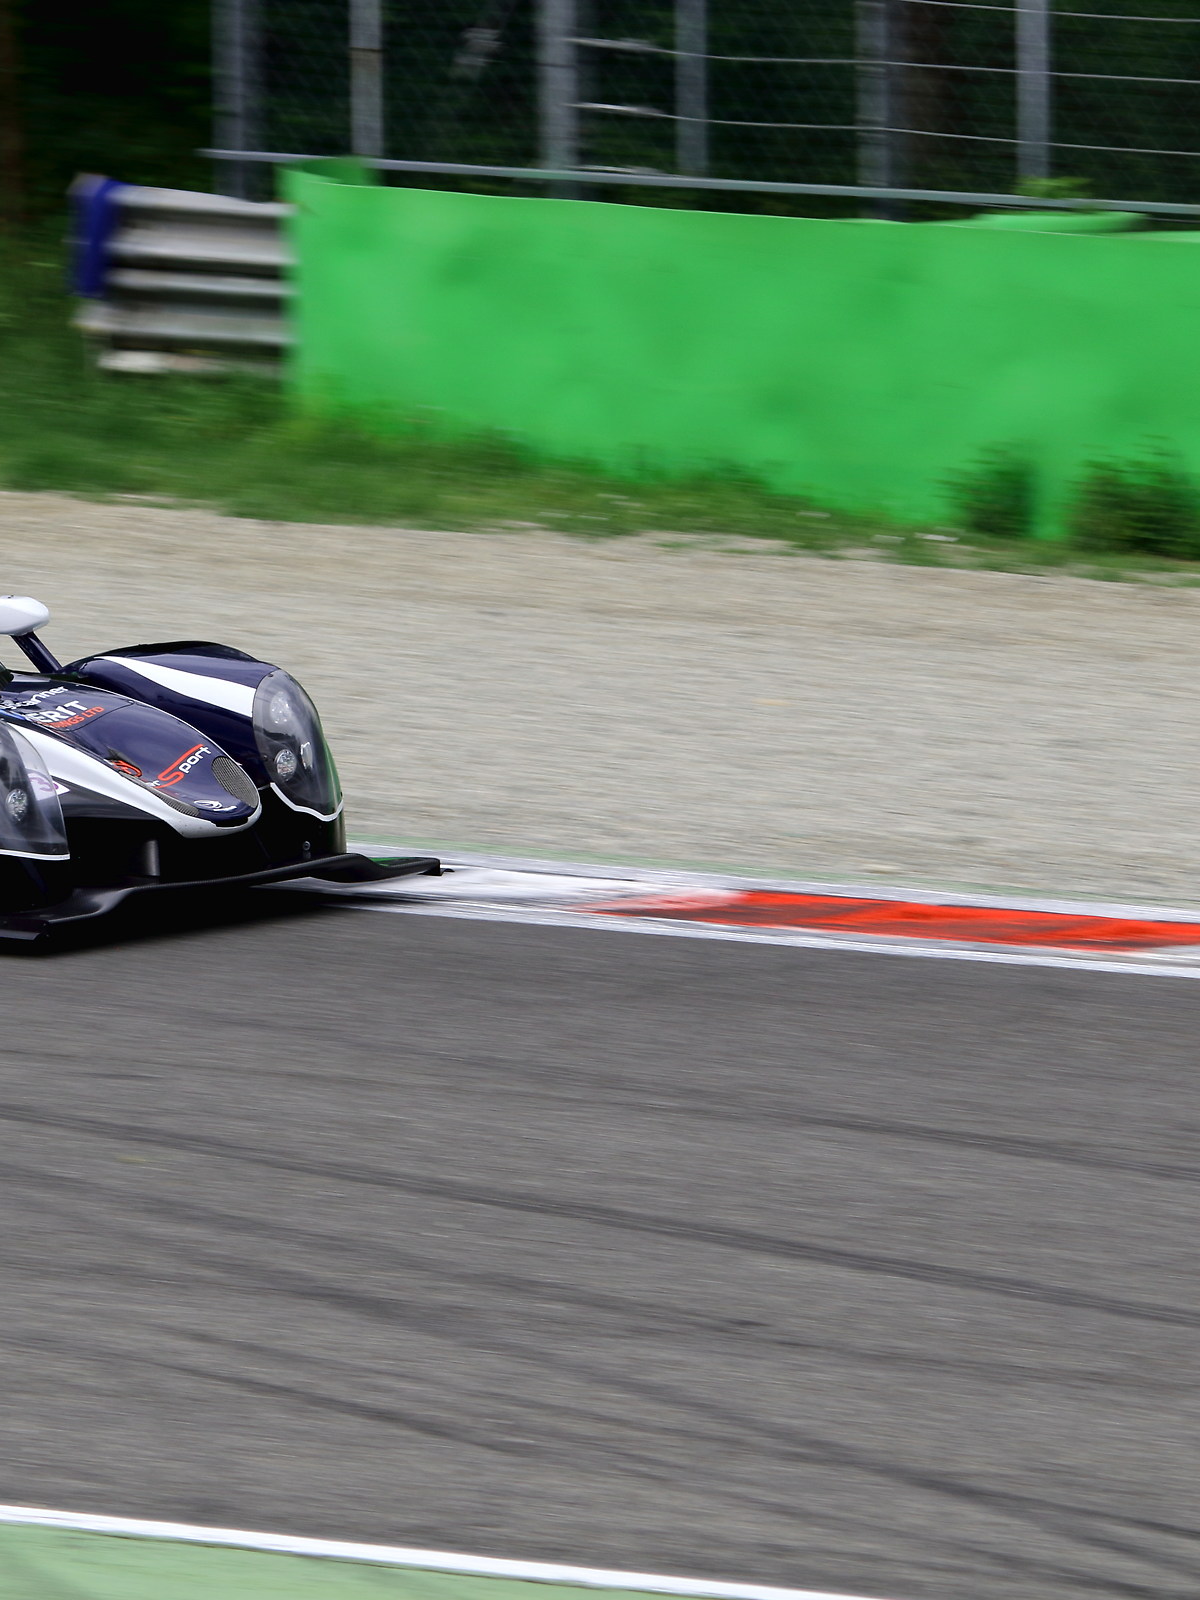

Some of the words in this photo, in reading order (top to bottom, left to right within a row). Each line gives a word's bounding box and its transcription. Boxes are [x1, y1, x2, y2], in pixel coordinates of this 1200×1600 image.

[24, 700, 88, 723] ERIT
[81, 706, 105, 718] LTD
[155, 744, 212, 788] Sport
